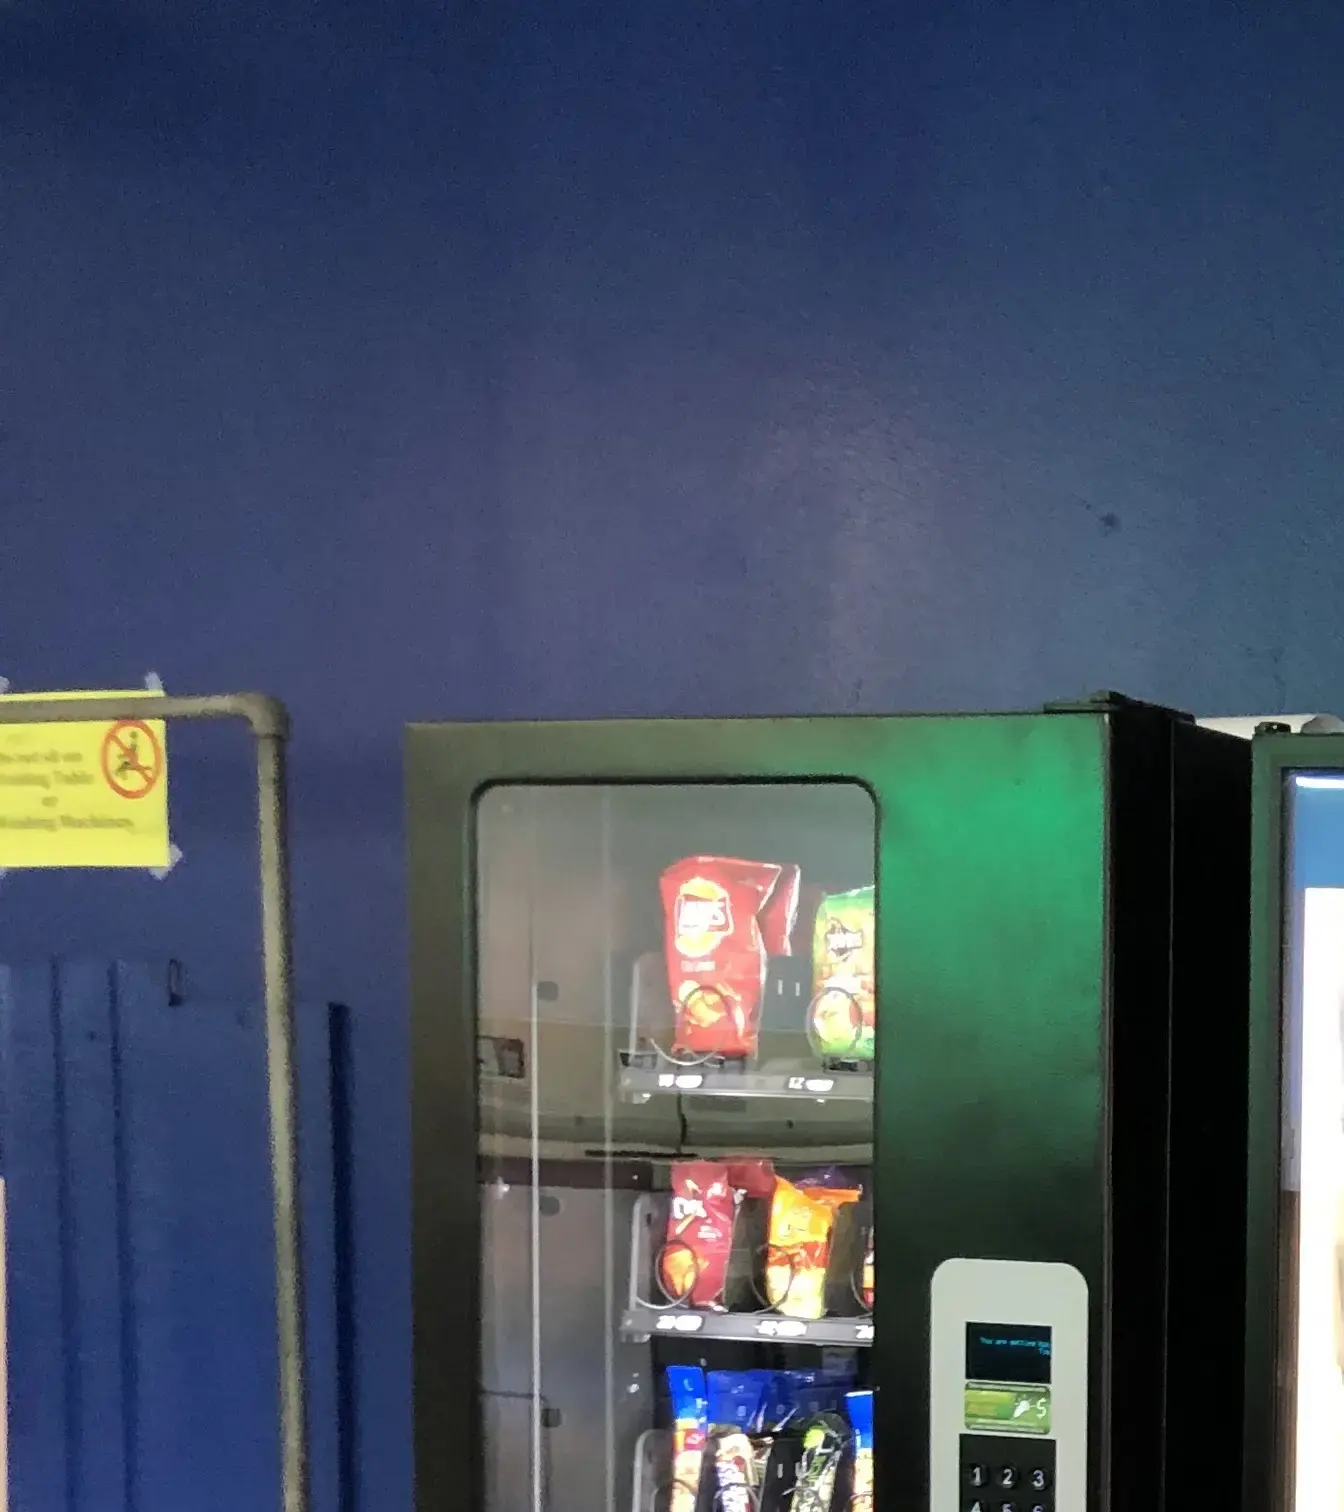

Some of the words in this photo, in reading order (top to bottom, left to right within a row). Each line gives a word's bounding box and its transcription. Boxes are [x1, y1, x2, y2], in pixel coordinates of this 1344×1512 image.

[972, 1467, 982, 1485] 1
[1003, 1468, 1013, 1486] 2
[1033, 1470, 1044, 1487] 3
